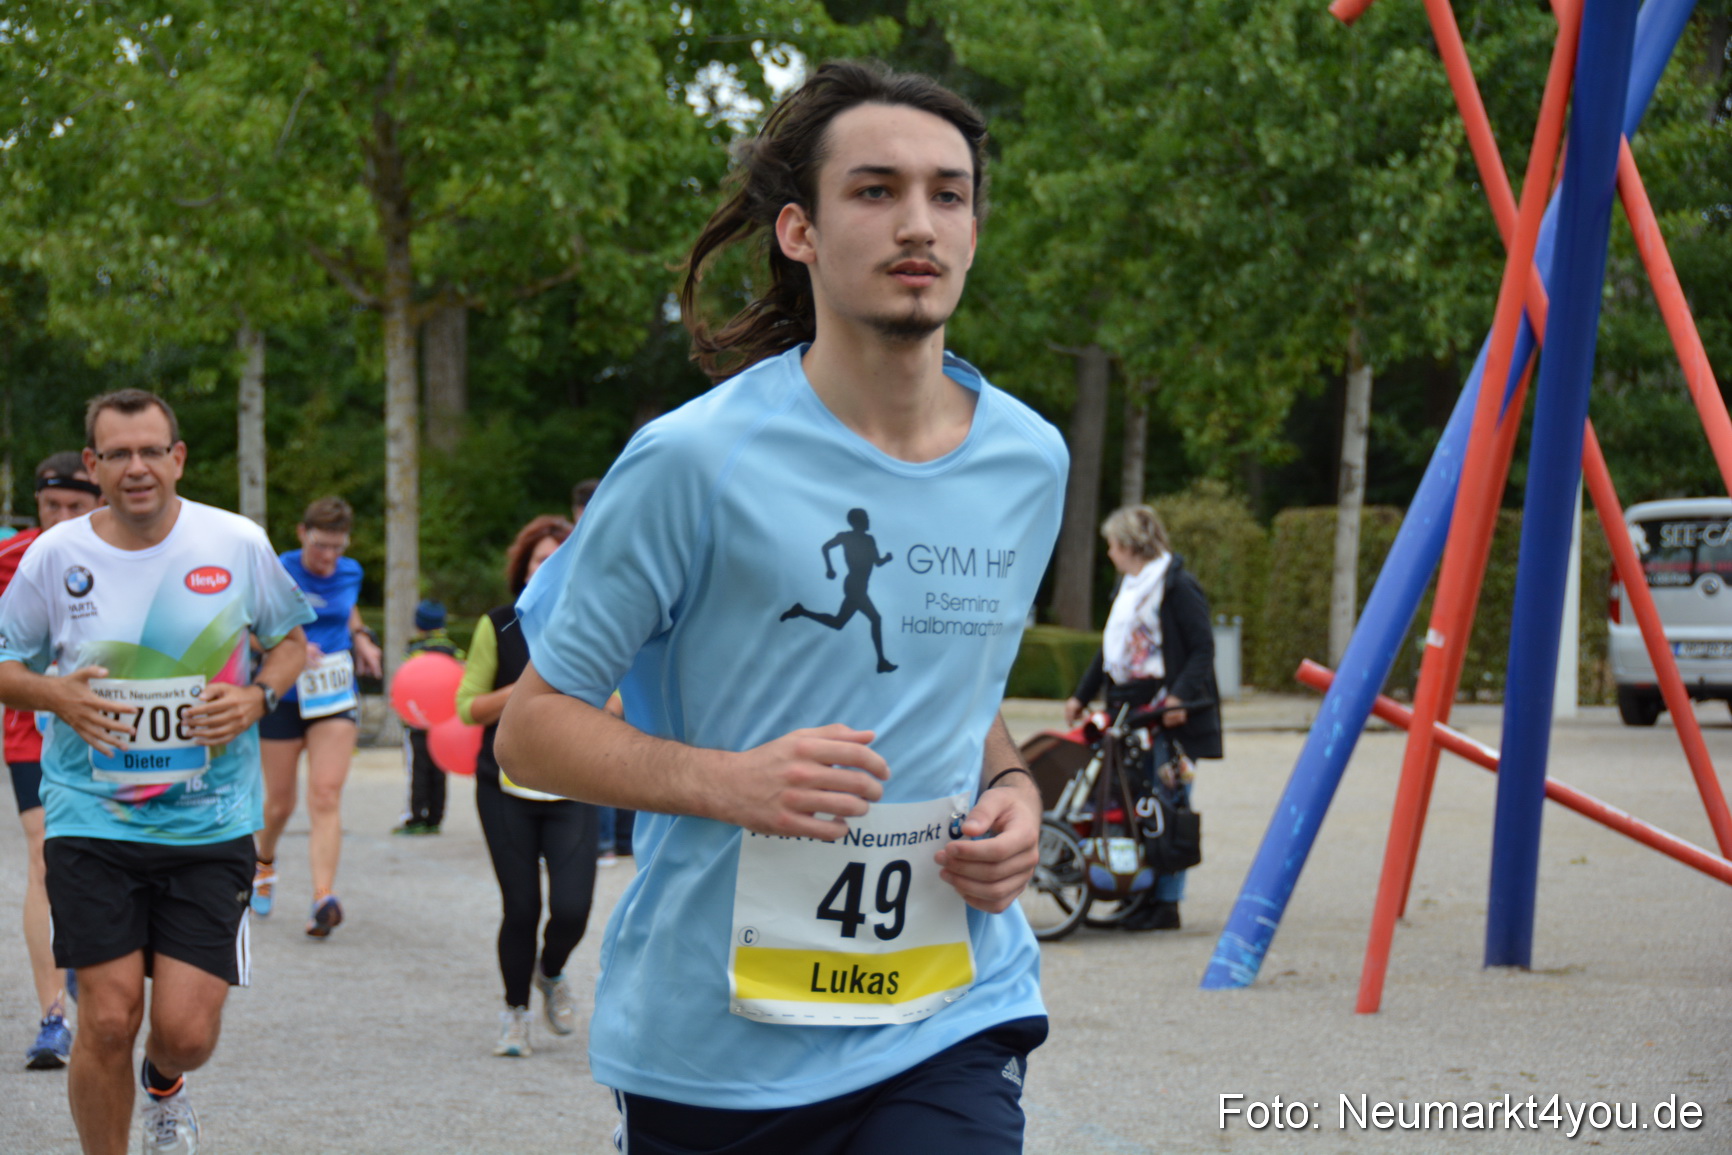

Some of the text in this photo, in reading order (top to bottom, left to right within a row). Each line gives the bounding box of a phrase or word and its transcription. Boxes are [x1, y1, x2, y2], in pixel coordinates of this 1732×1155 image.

[907, 543, 1016, 579] GYM HIP
[925, 592, 999, 613] P-Seminar
[129, 689, 186, 701] Neumarkt
[124, 753, 172, 769] Dieter
[843, 822, 942, 848] Neumarkt
[816, 859, 912, 941] 49
[743, 929, 754, 944] C
[810, 962, 899, 996] Lukas
